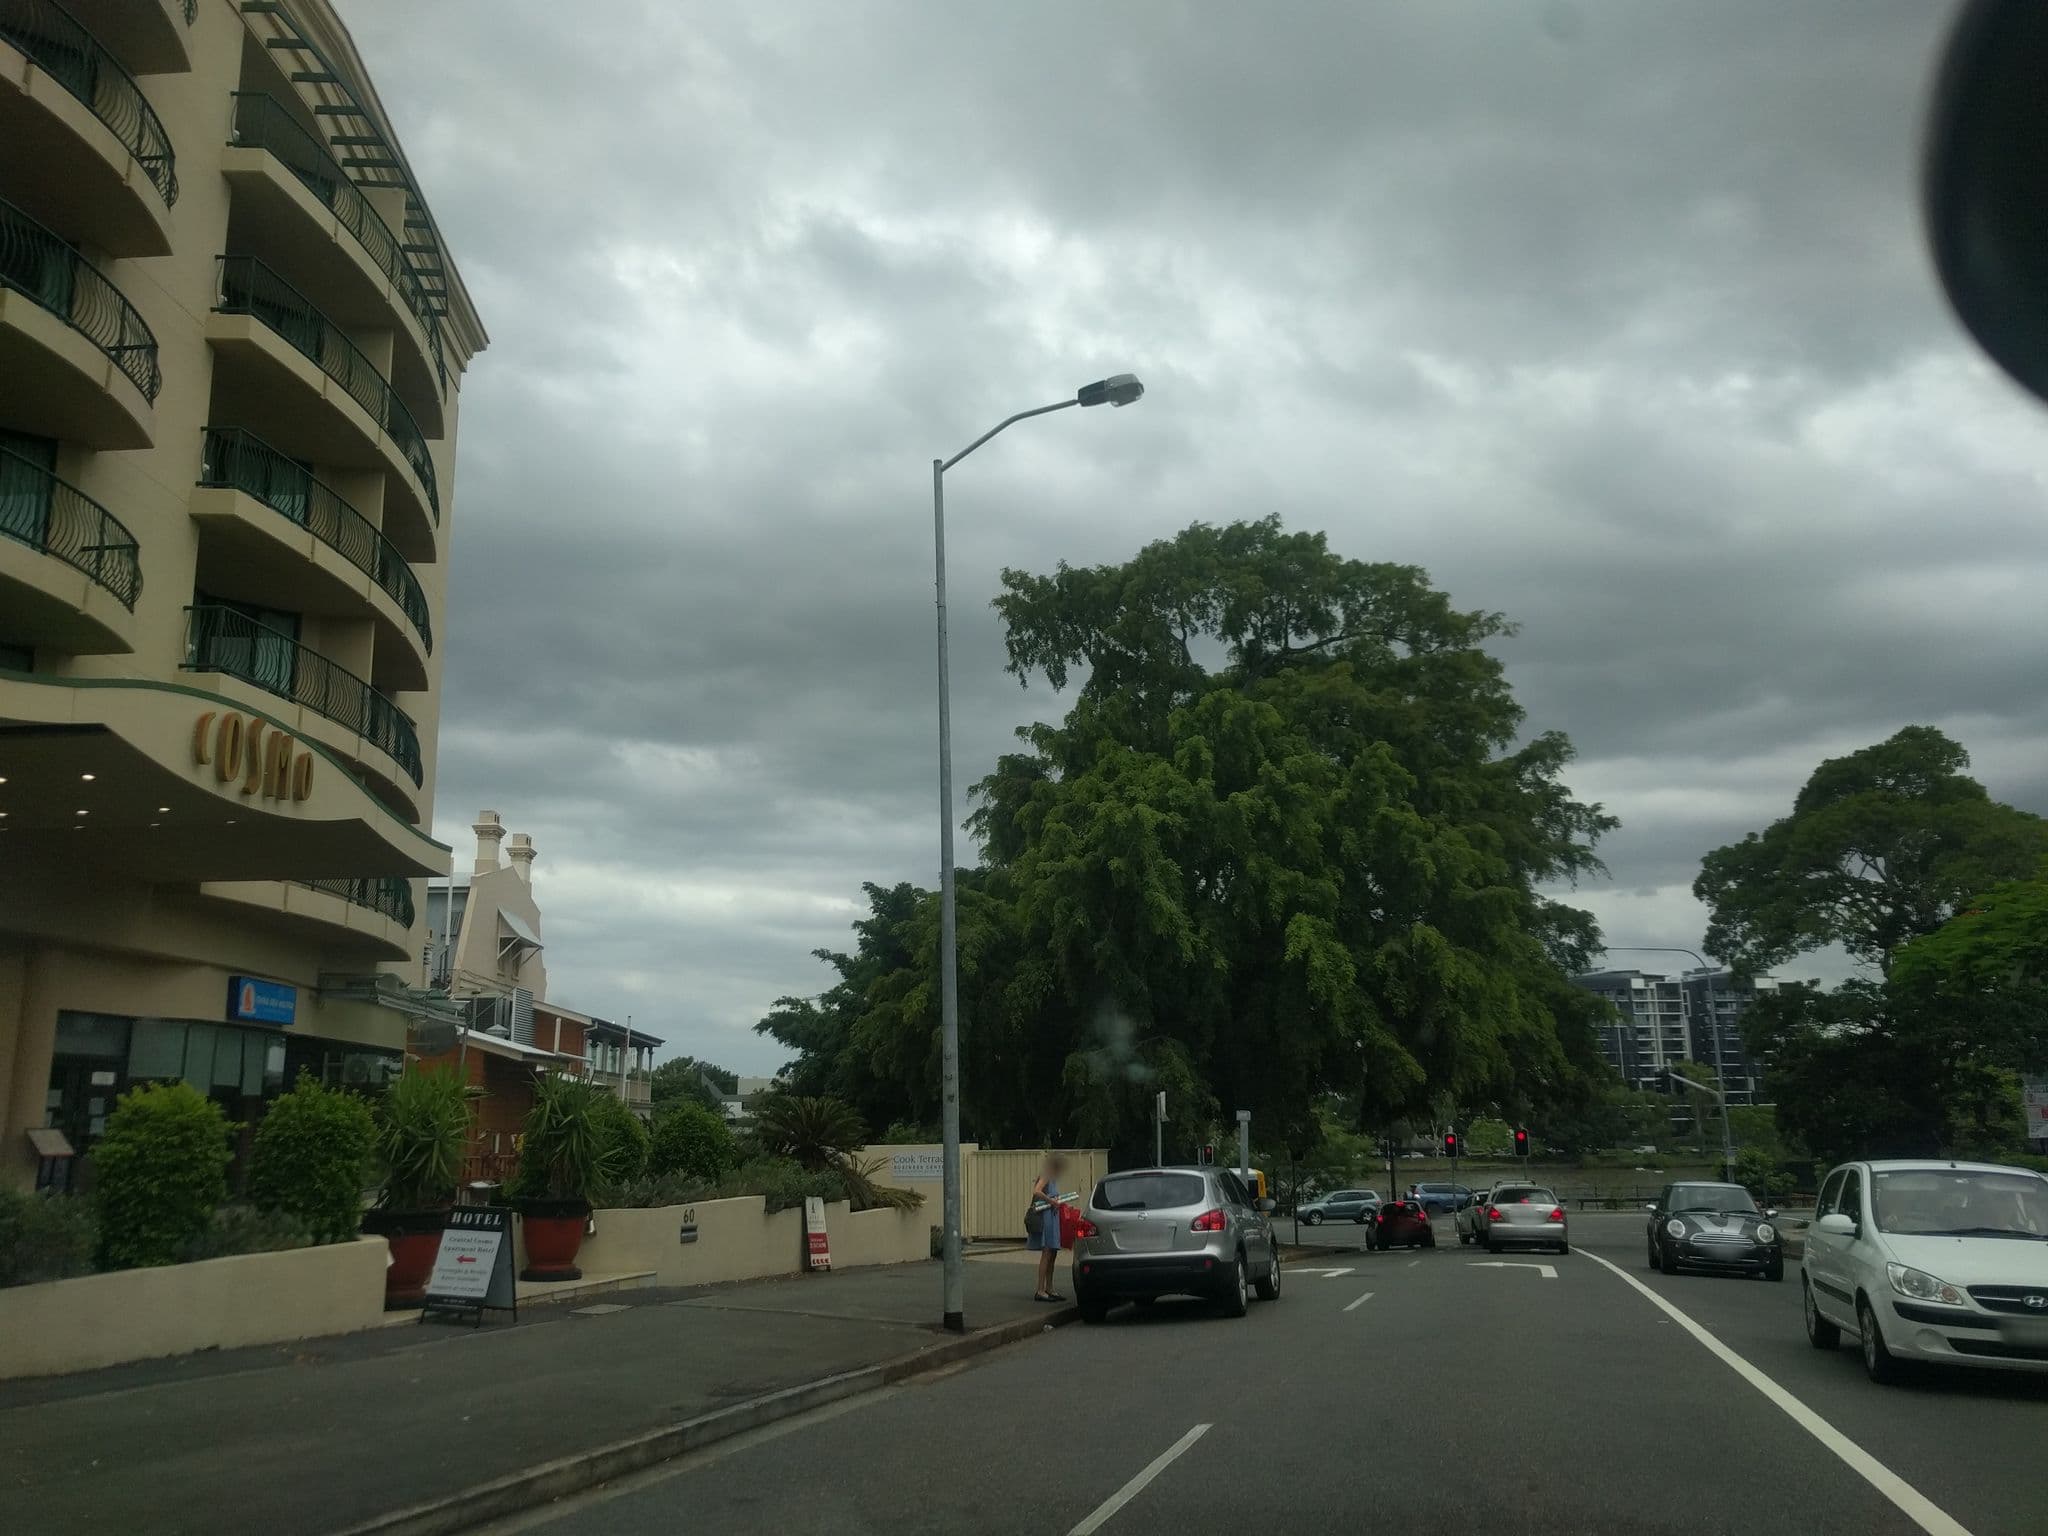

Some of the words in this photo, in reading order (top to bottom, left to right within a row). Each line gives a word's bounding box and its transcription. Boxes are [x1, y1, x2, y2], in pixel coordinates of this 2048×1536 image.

[194, 711, 314, 801] COSMO
[894, 1155, 915, 1164] Cook
[919, 1155, 944, 1163] Terrac
[451, 1212, 501, 1225] HOTEL
[683, 1208, 695, 1224] 60
